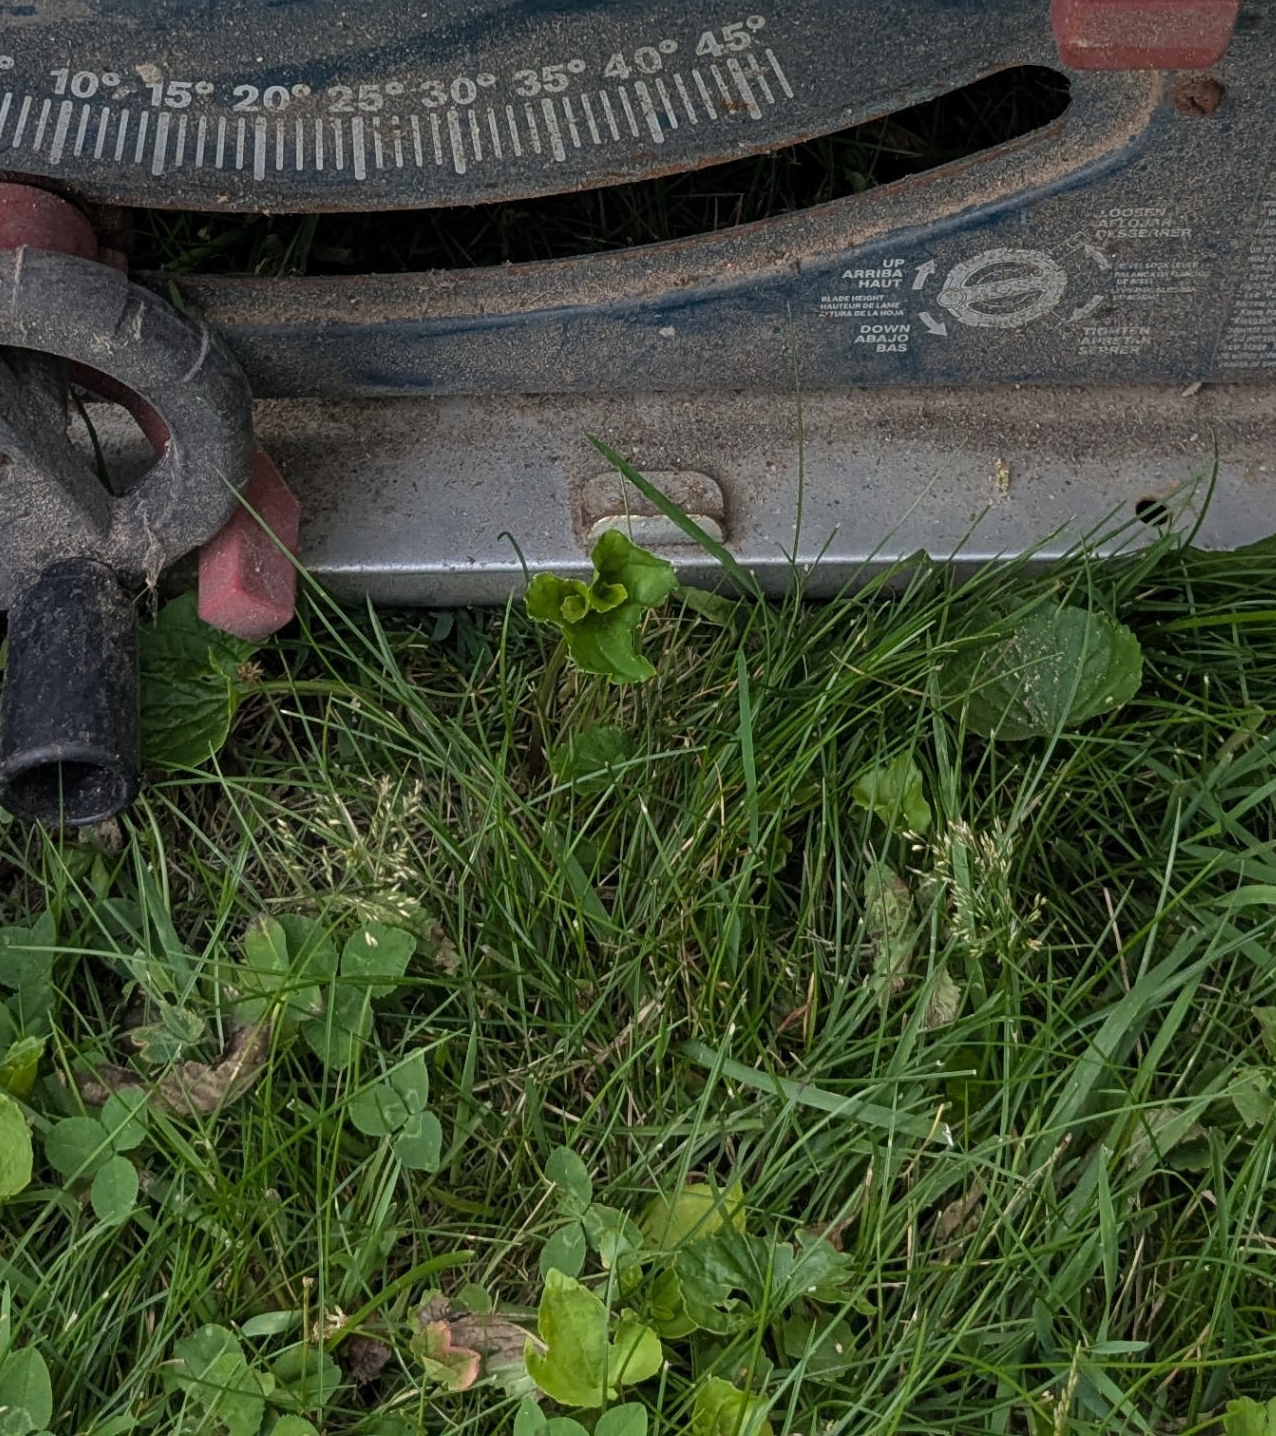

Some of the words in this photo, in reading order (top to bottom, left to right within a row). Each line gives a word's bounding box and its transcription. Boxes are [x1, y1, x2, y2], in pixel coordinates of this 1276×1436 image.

[49, 67, 121, 99] 10°
[145, 80, 215, 110] 15°
[232, 83, 311, 113] 20°
[327, 80, 405, 113] 25°
[421, 72, 496, 108] 30°
[513, 58, 587, 97] 35°
[603, 39, 679, 81] 40°
[695, 14, 766, 58] 45°
[883, 258, 905, 268] UP
[842, 268, 903, 279] ARRIBA
[858, 278, 903, 289] HAUT
[821, 295, 850, 303] BLADE
[851, 294, 884, 302] HEIGHT
[820, 302, 861, 310] HAUTEUR
[860, 324, 911, 334] DOWN
[854, 334, 909, 344] ABAJO
[876, 343, 907, 352] BAS
